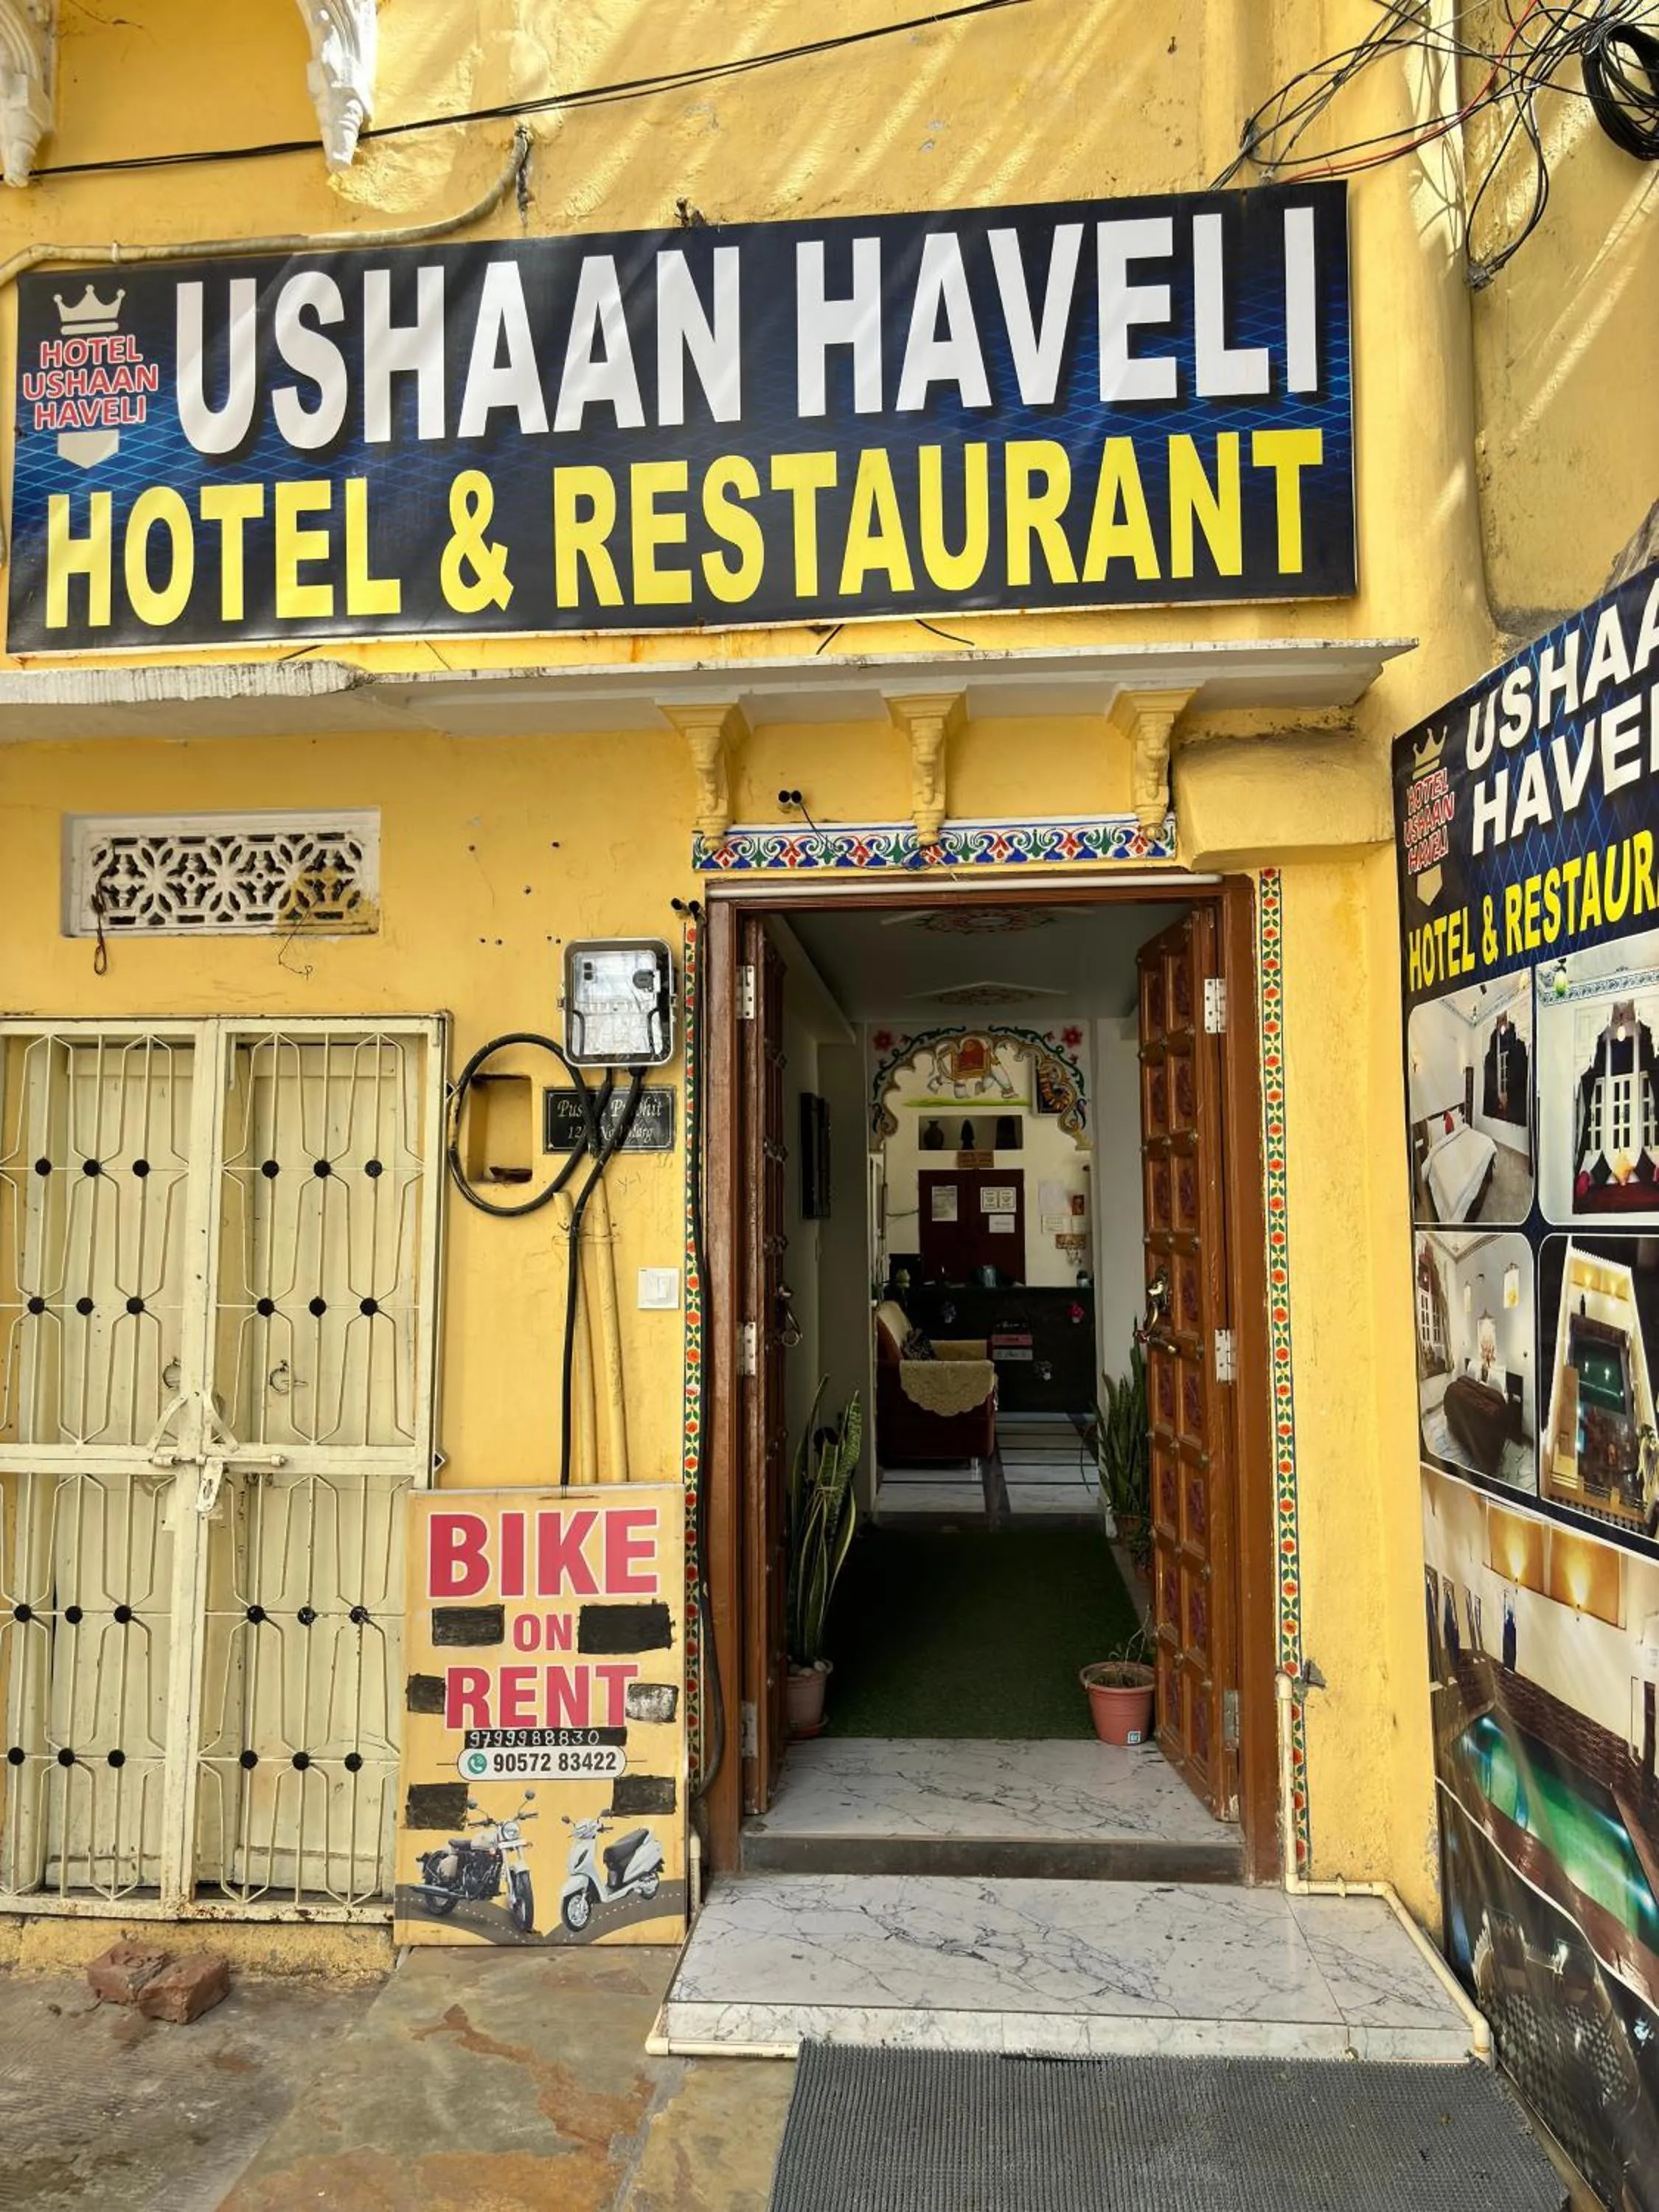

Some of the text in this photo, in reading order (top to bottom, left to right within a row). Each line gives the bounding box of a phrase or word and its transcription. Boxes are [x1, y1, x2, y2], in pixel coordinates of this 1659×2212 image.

[40, 334, 143, 369] HOTEL
[176, 207, 1318, 453] USHAAN HAVELI
[23, 364, 159, 400] USHAAN
[35, 395, 146, 431] HAVELI
[46, 428, 1323, 629] HOTEL & RESTAURANT
[1406, 767, 1448, 816] HOTEL
[1472, 683, 1659, 857] HAVE
[1404, 791, 1455, 847] USHAAN
[1408, 825, 1448, 875] HAVELI
[1409, 830, 1659, 992] HOTEL & RESTAUR
[428, 1508, 658, 1599] BIKE
[512, 1613, 573, 1653] ON
[446, 1664, 639, 1730] RENT
[469, 1729, 600, 1748] 9799988830
[493, 1751, 616, 1773] 90572 83422
